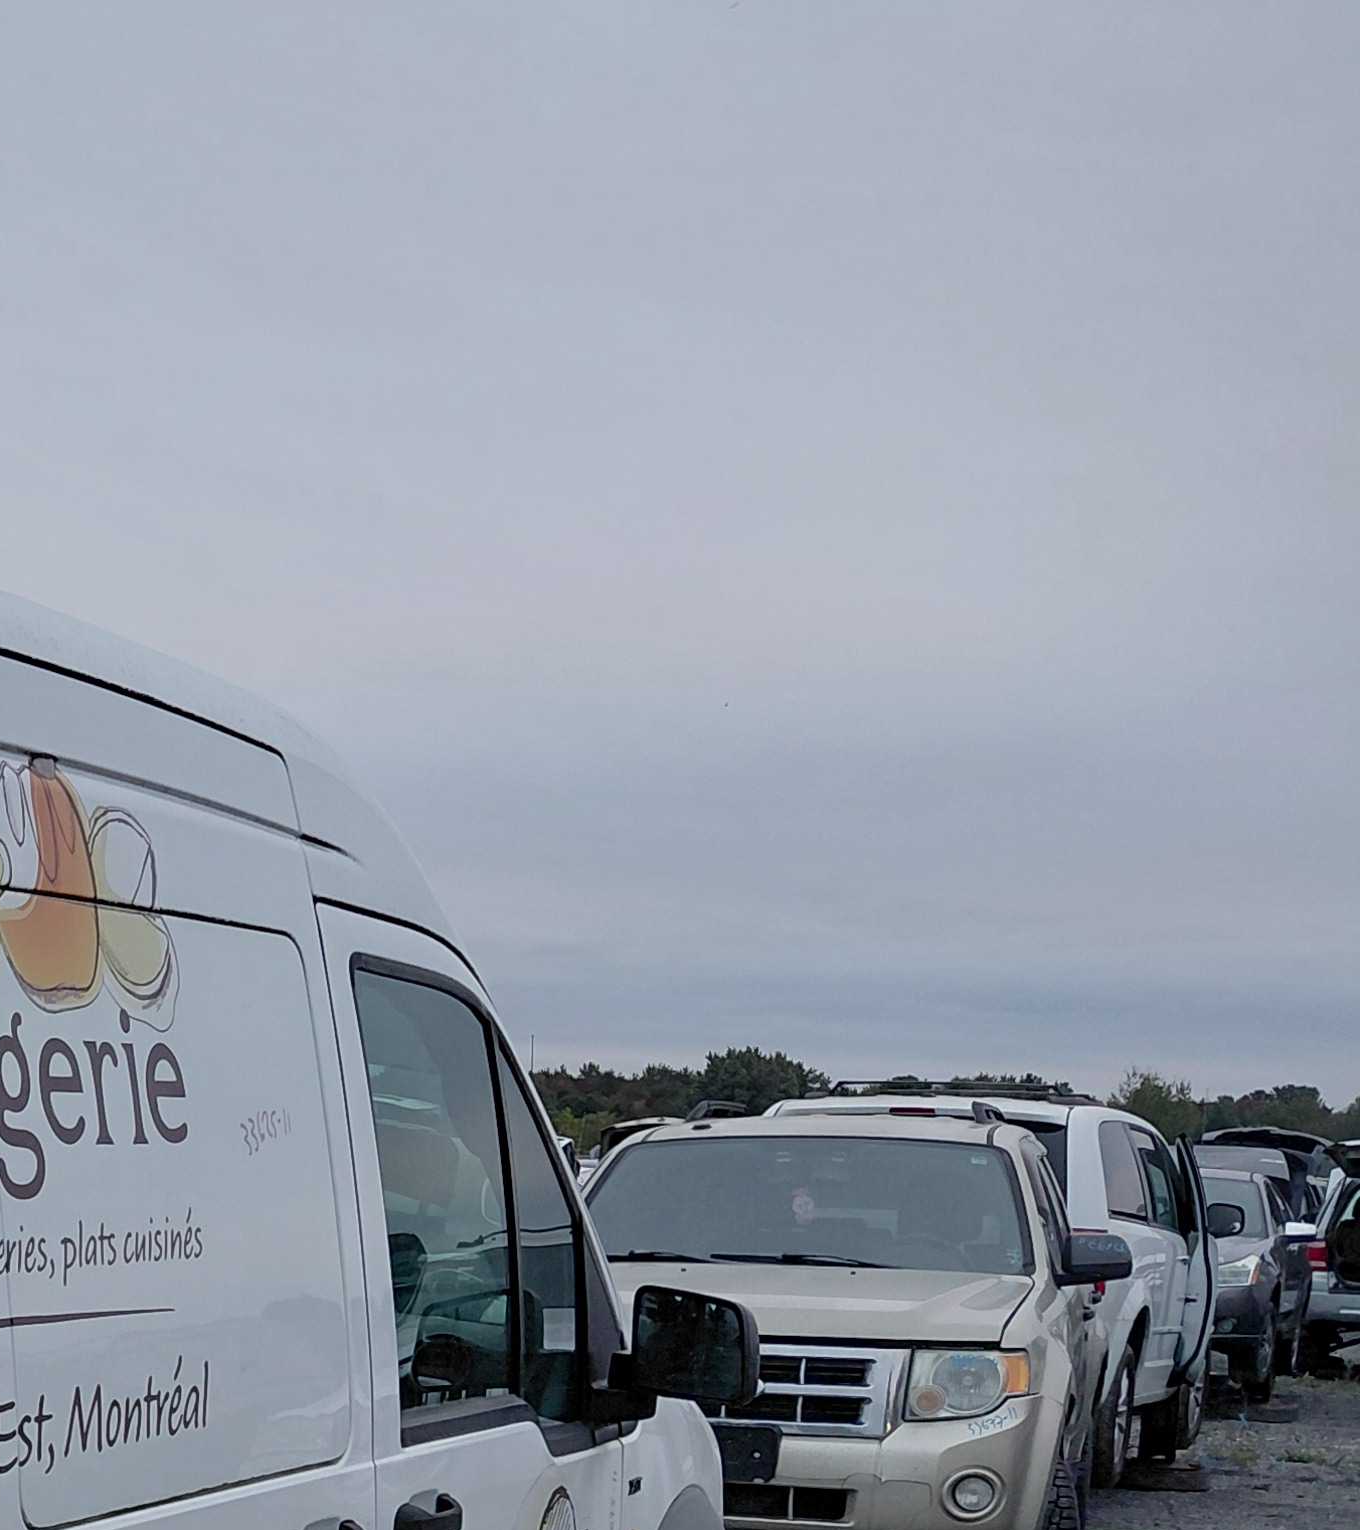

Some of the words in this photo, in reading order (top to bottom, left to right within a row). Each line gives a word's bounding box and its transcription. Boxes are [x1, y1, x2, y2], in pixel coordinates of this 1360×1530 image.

[61, 1219, 118, 1287] plats
[122, 1208, 204, 1265] cuisinés
[63, 1355, 210, 1460] Montréal
